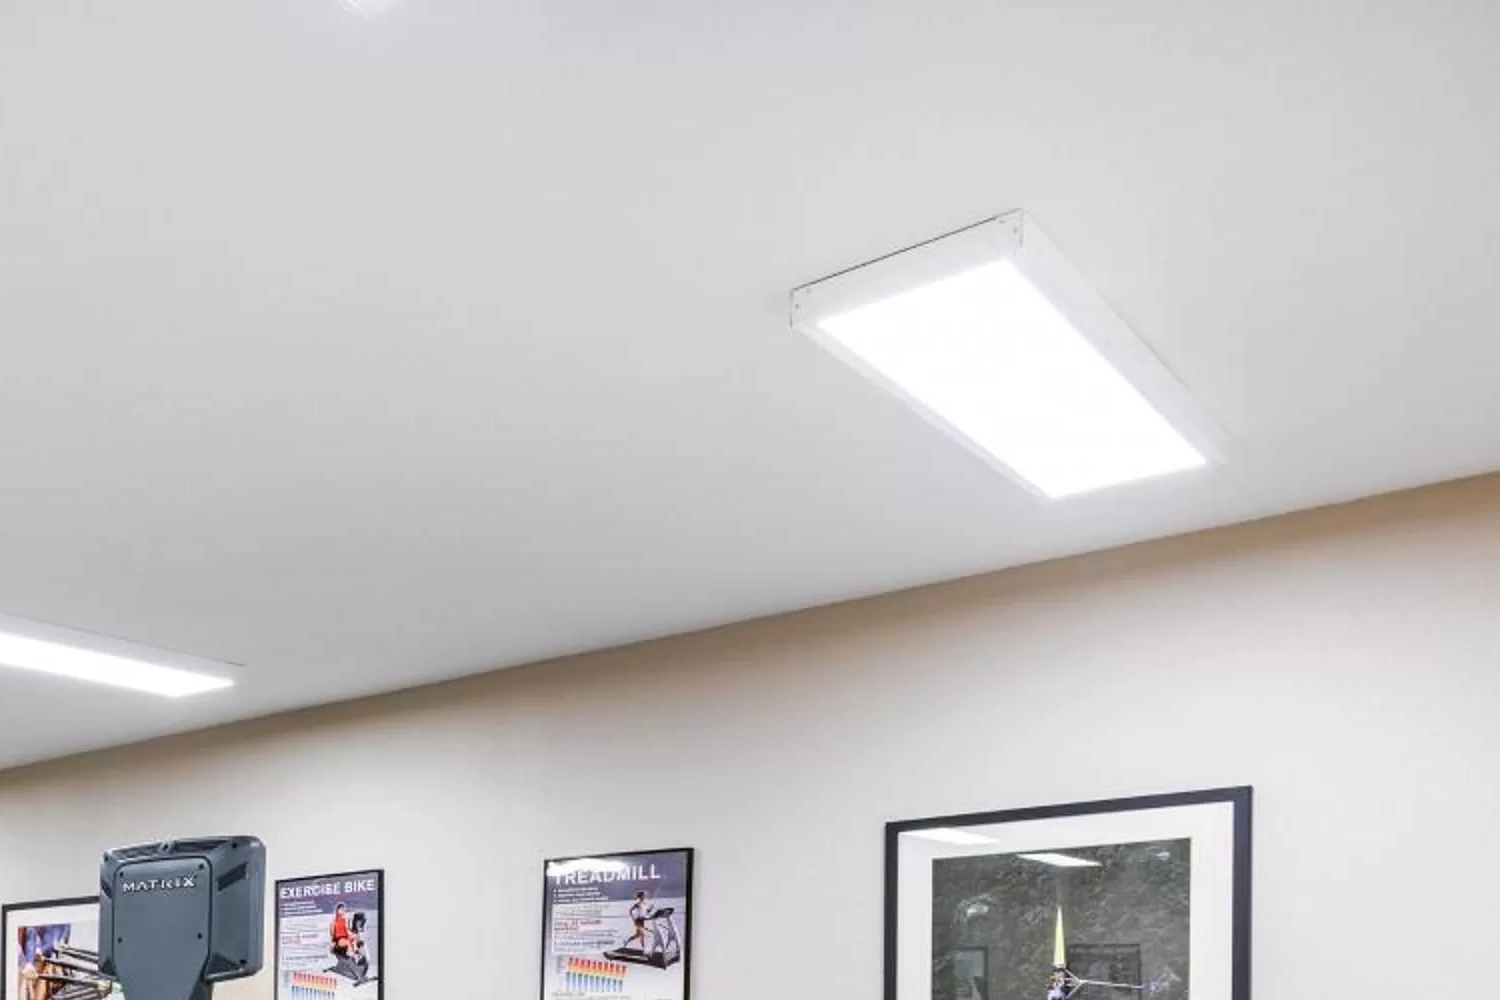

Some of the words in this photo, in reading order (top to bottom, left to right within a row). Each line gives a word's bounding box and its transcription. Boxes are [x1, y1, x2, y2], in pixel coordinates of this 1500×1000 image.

[122, 875, 196, 893] MATRIX
[280, 882, 341, 899] EXERCISE
[343, 879, 376, 894] BIKE
